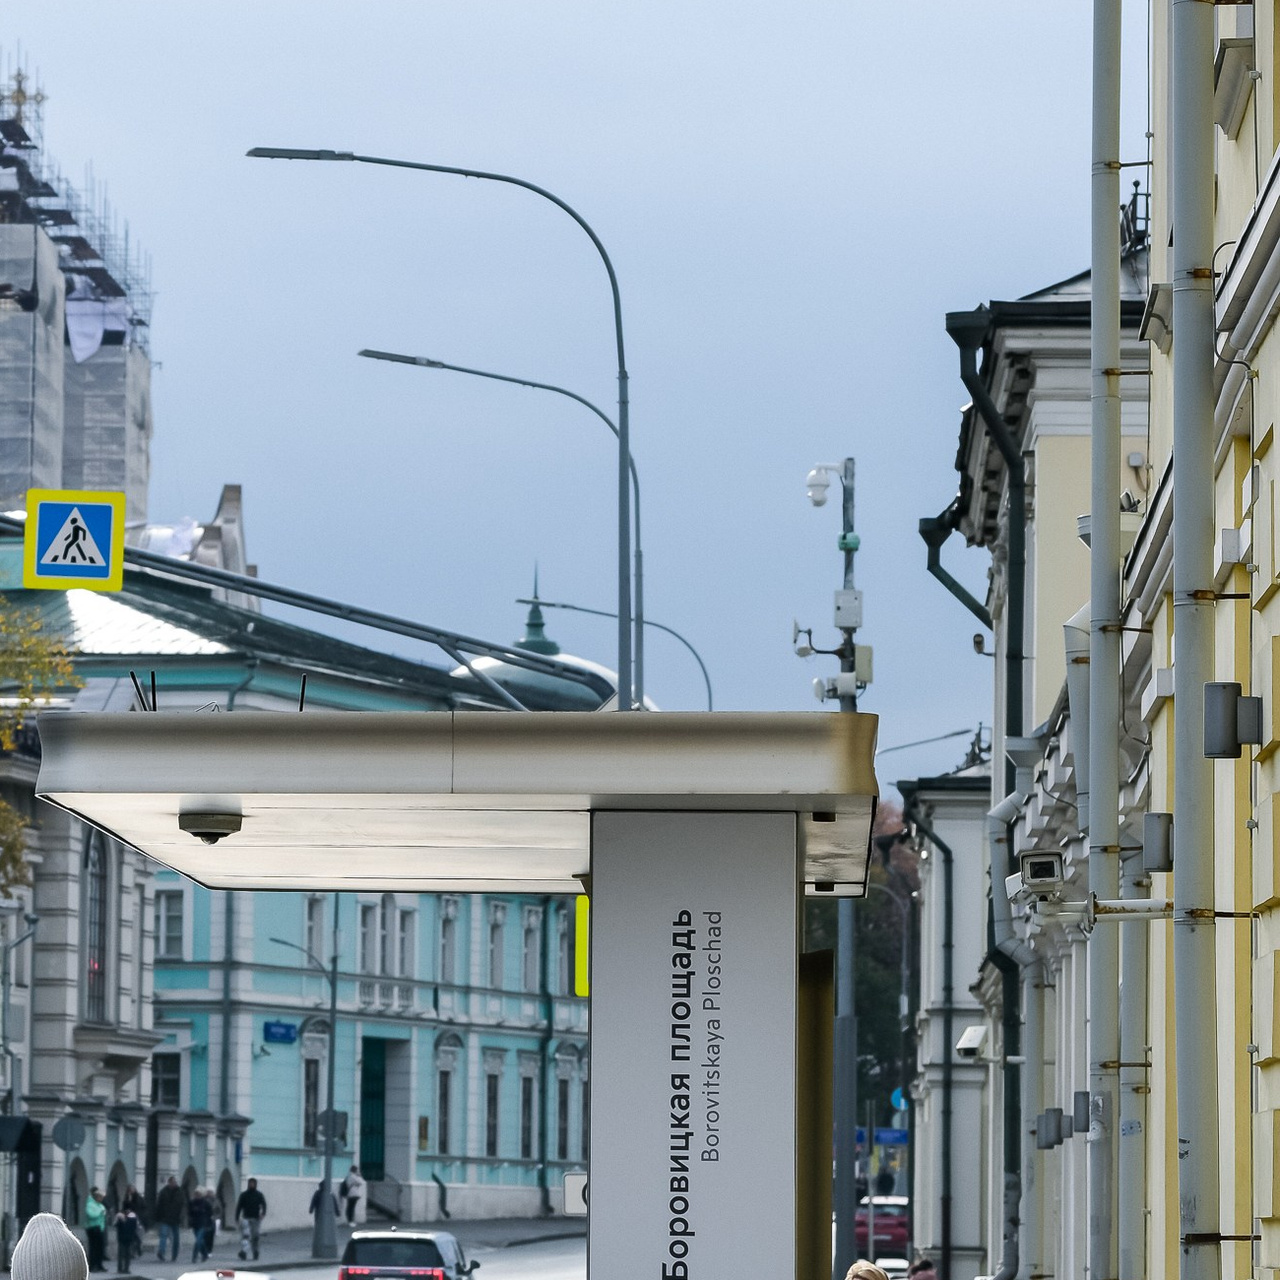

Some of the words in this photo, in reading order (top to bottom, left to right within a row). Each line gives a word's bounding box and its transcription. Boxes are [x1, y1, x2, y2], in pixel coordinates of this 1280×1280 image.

[670, 909, 697, 1061] площадь
[701, 911, 722, 1011] Ploschad
[700, 1019, 725, 1162] Borovitskaya
[661, 1073, 696, 1280] Боровицкая
